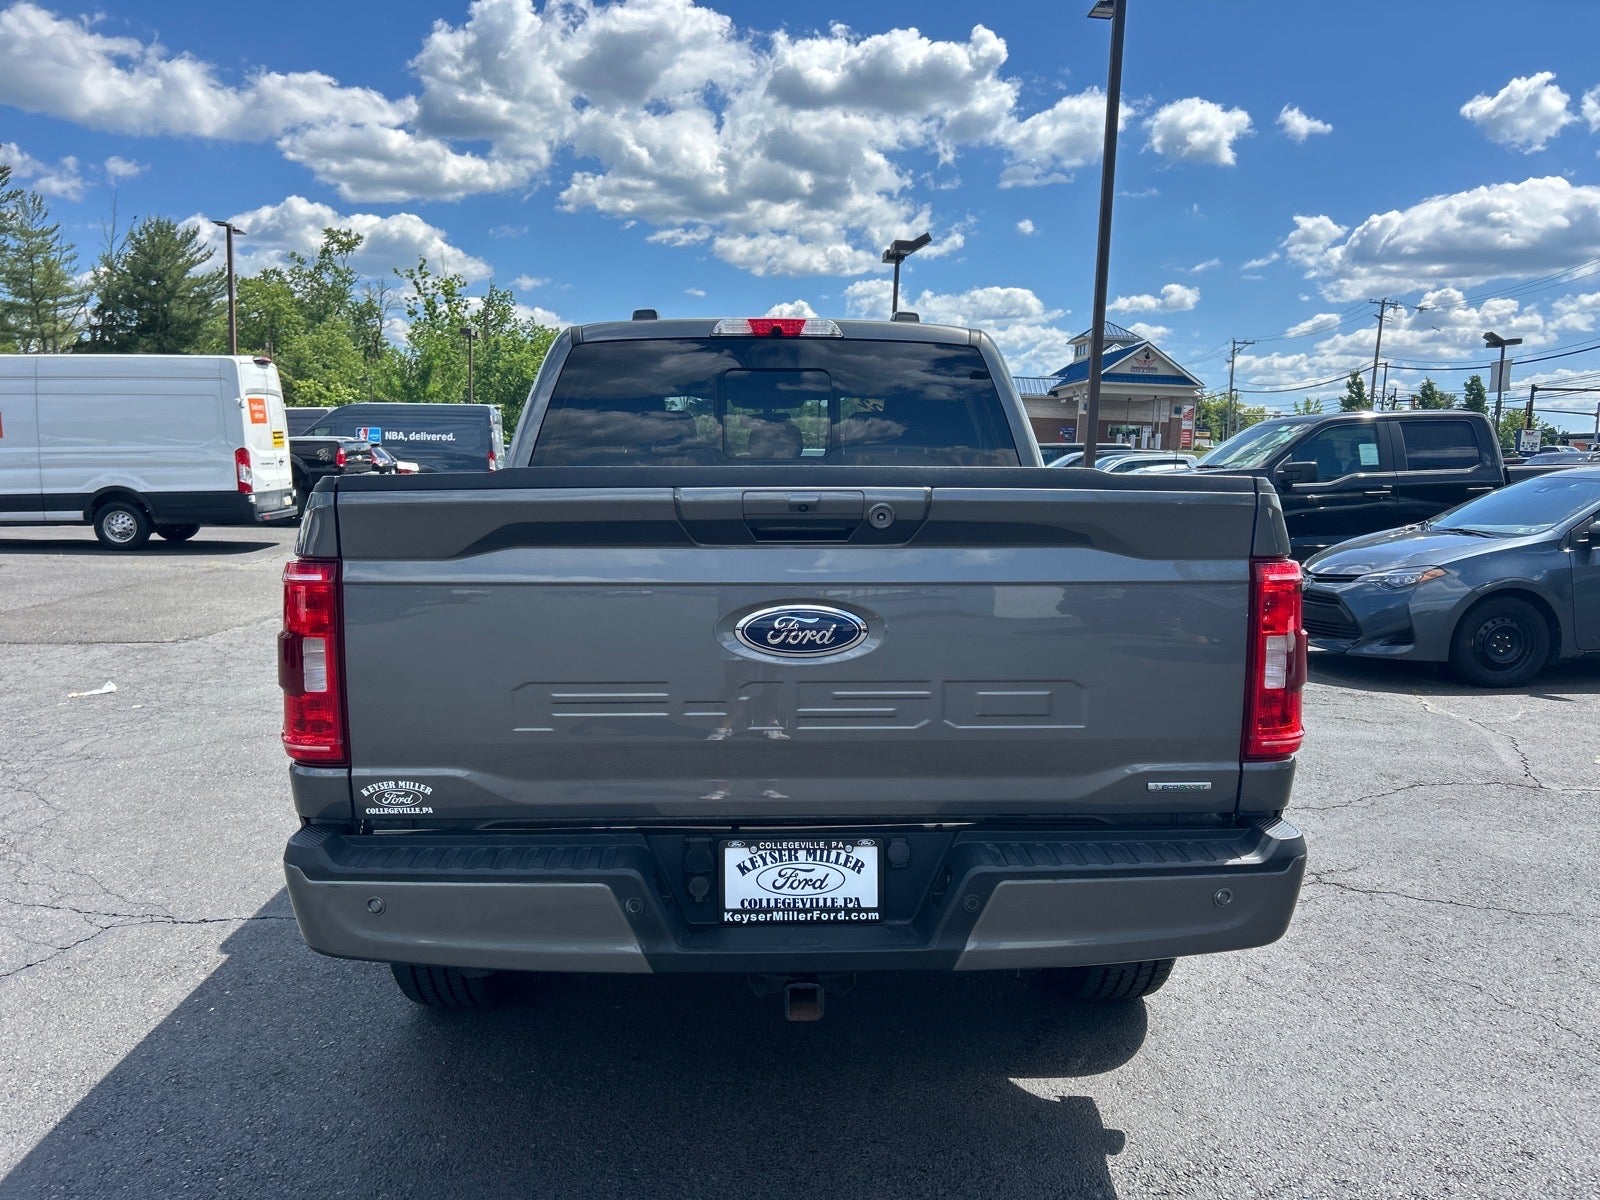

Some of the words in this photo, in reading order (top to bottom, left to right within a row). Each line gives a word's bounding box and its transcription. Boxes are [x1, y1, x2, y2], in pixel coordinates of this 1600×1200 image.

[385, 431, 407, 441] NBA,
[409, 432, 456, 441] delivered.
[767, 616, 836, 645] Ford
[511, 681, 1087, 730] F-150
[361, 781, 395, 796] KEYSER
[399, 781, 432, 795] MILLER
[382, 791, 413, 804] Ford
[736, 850, 799, 877] KEYSER
[806, 850, 865, 875] MILLER
[772, 867, 829, 890] Ford
[724, 911, 879, 923] KeyserMillerFord.com
